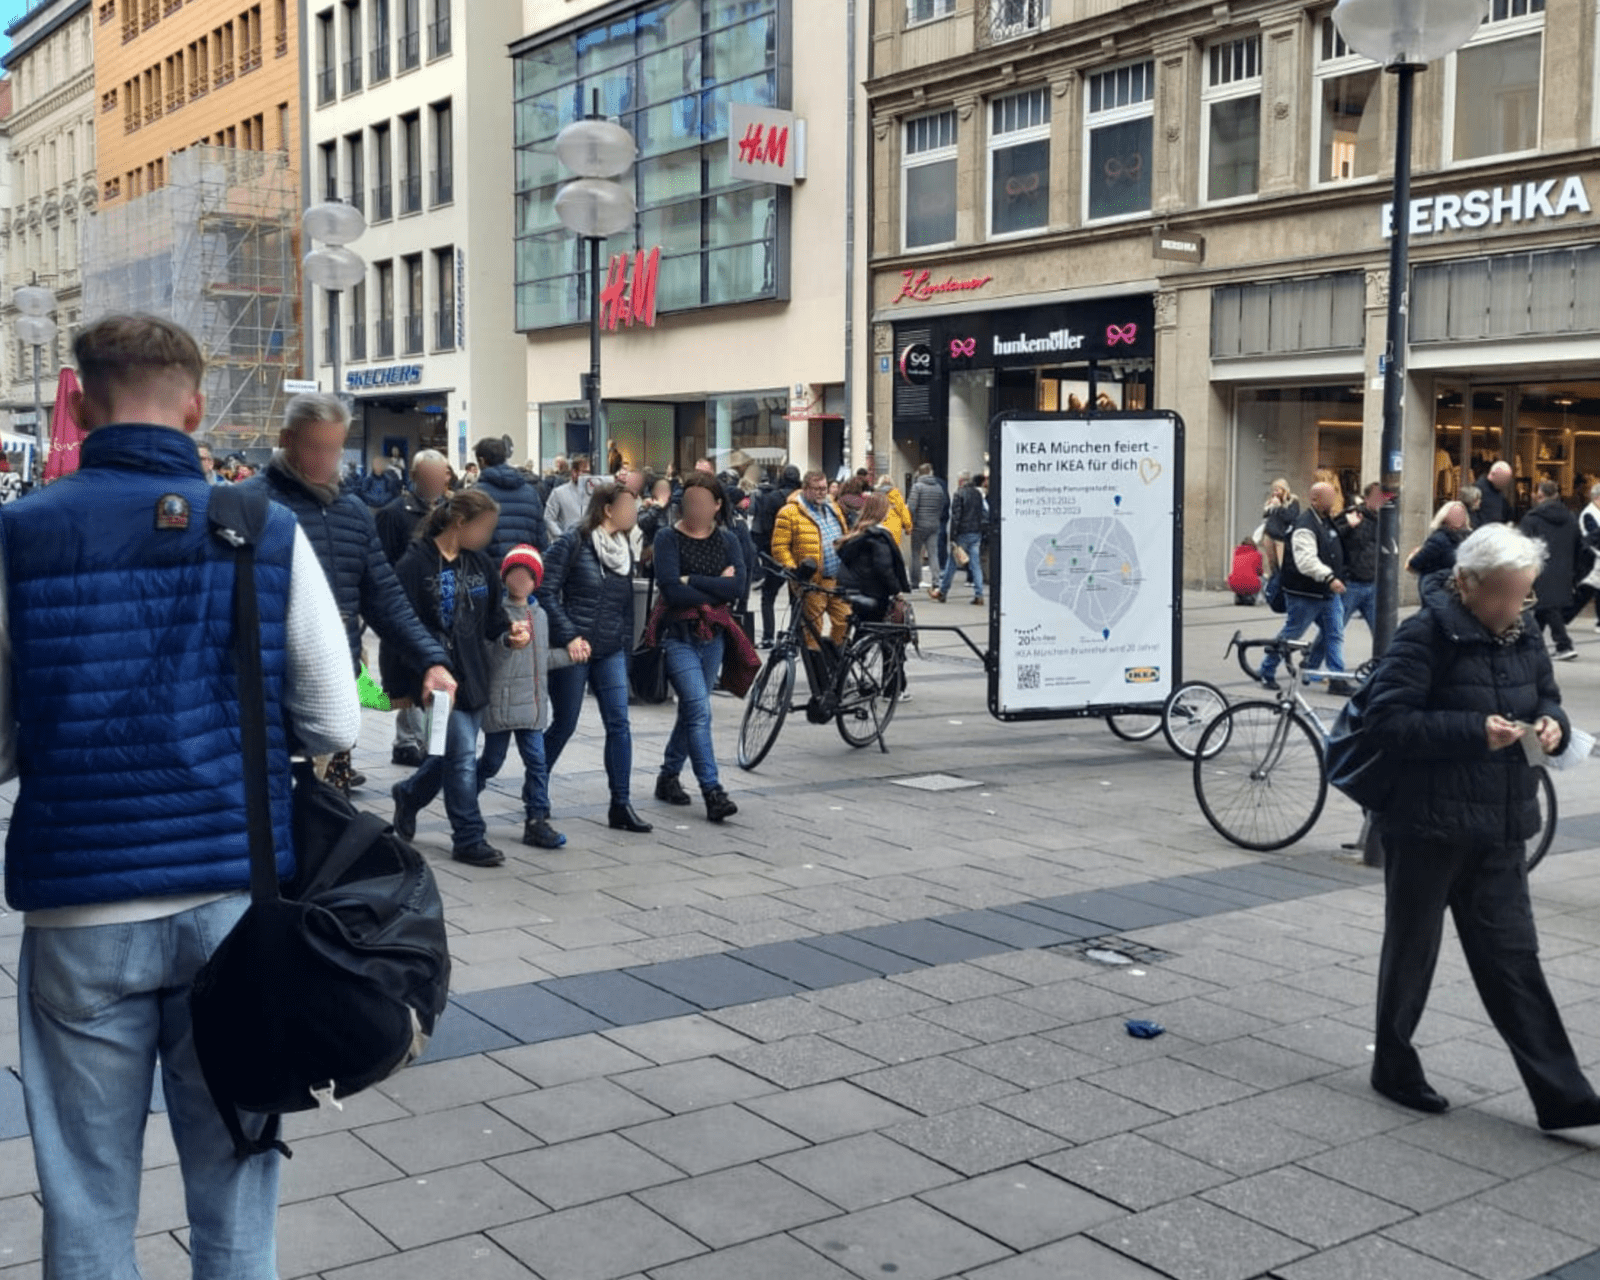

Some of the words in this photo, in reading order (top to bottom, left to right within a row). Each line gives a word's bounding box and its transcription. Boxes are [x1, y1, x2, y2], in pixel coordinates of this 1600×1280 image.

[738, 122, 790, 168] H&M
[1161, 239, 1197, 252] BERSHKA
[599, 246, 661, 331] H&M
[993, 329, 1085, 356] hunkemöller
[346, 363, 424, 390] SKECHERS
[1015, 442, 1047, 454] IKEA
[1050, 441, 1111, 454] München
[1114, 440, 1150, 452] feiert
[1015, 460, 1053, 472] mehr
[1056, 459, 1085, 471] IKEA
[1088, 458, 1107, 471] für
[1111, 458, 1138, 471] dich
